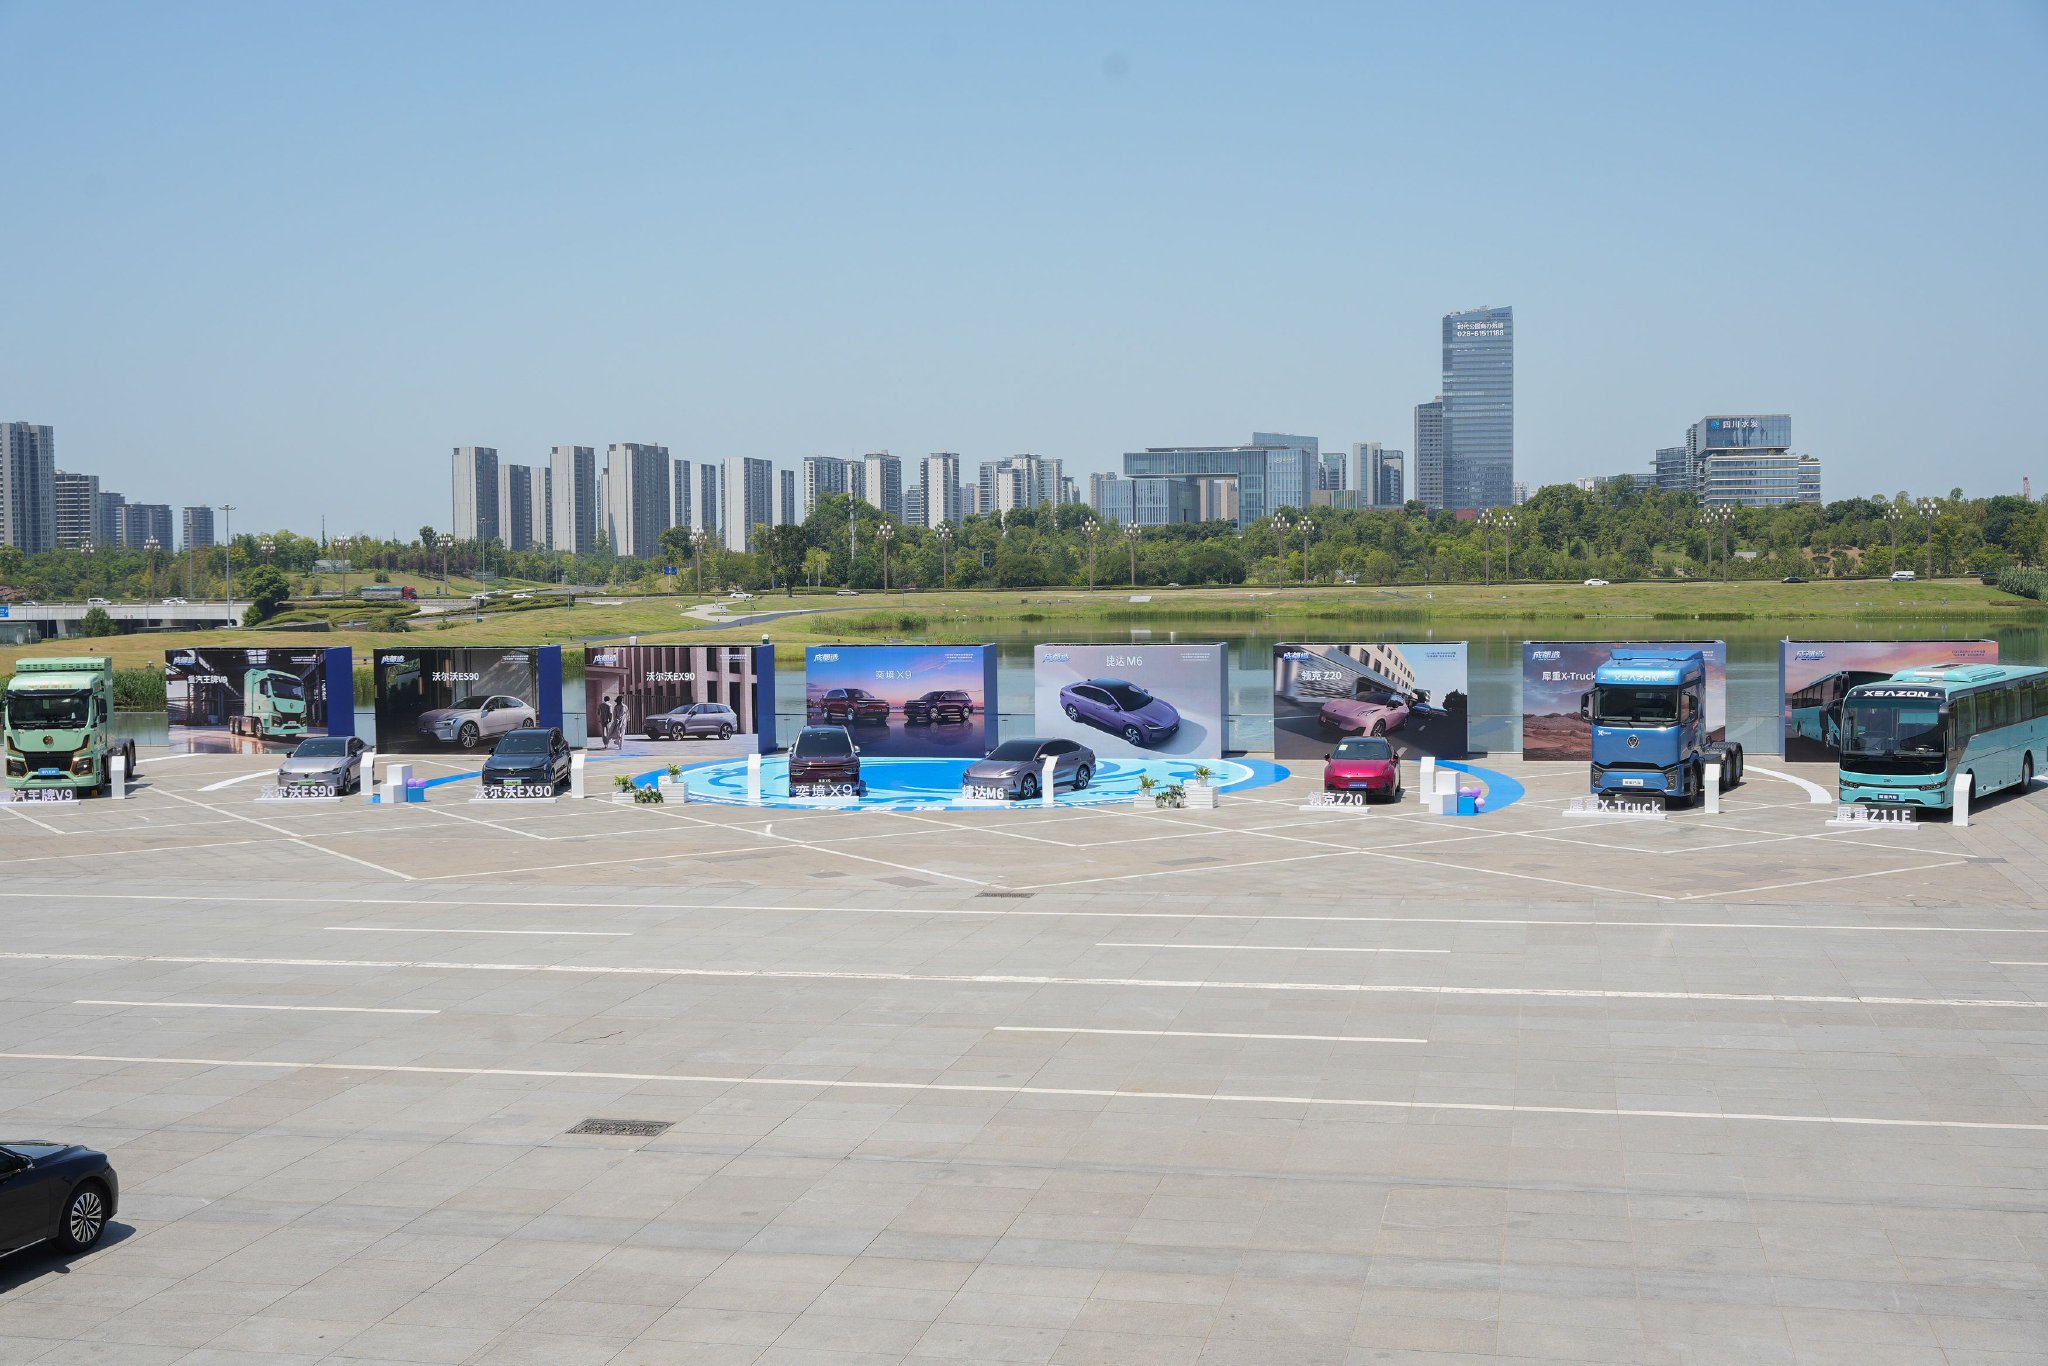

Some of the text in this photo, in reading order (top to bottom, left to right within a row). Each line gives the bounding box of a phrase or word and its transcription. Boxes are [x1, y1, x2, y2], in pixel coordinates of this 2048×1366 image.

[1722, 420, 1759, 429] 四川水发
[432, 671, 480, 682] 沃尔沃ES90
[646, 671, 696, 682] 沃尔沃EX90
[1301, 670, 1342, 681] 领克 Z20
[1614, 674, 1660, 682] XEAZON
[1863, 690, 1930, 698] XEAZON
[0, 788, 74, 802] 汽王牌V9
[261, 785, 336, 799] 沃尔沃ES90
[476, 784, 552, 799] 沃尔沃EX90
[962, 784, 1005, 800] 捷达M6
[1308, 790, 1364, 807] 领克Z20
